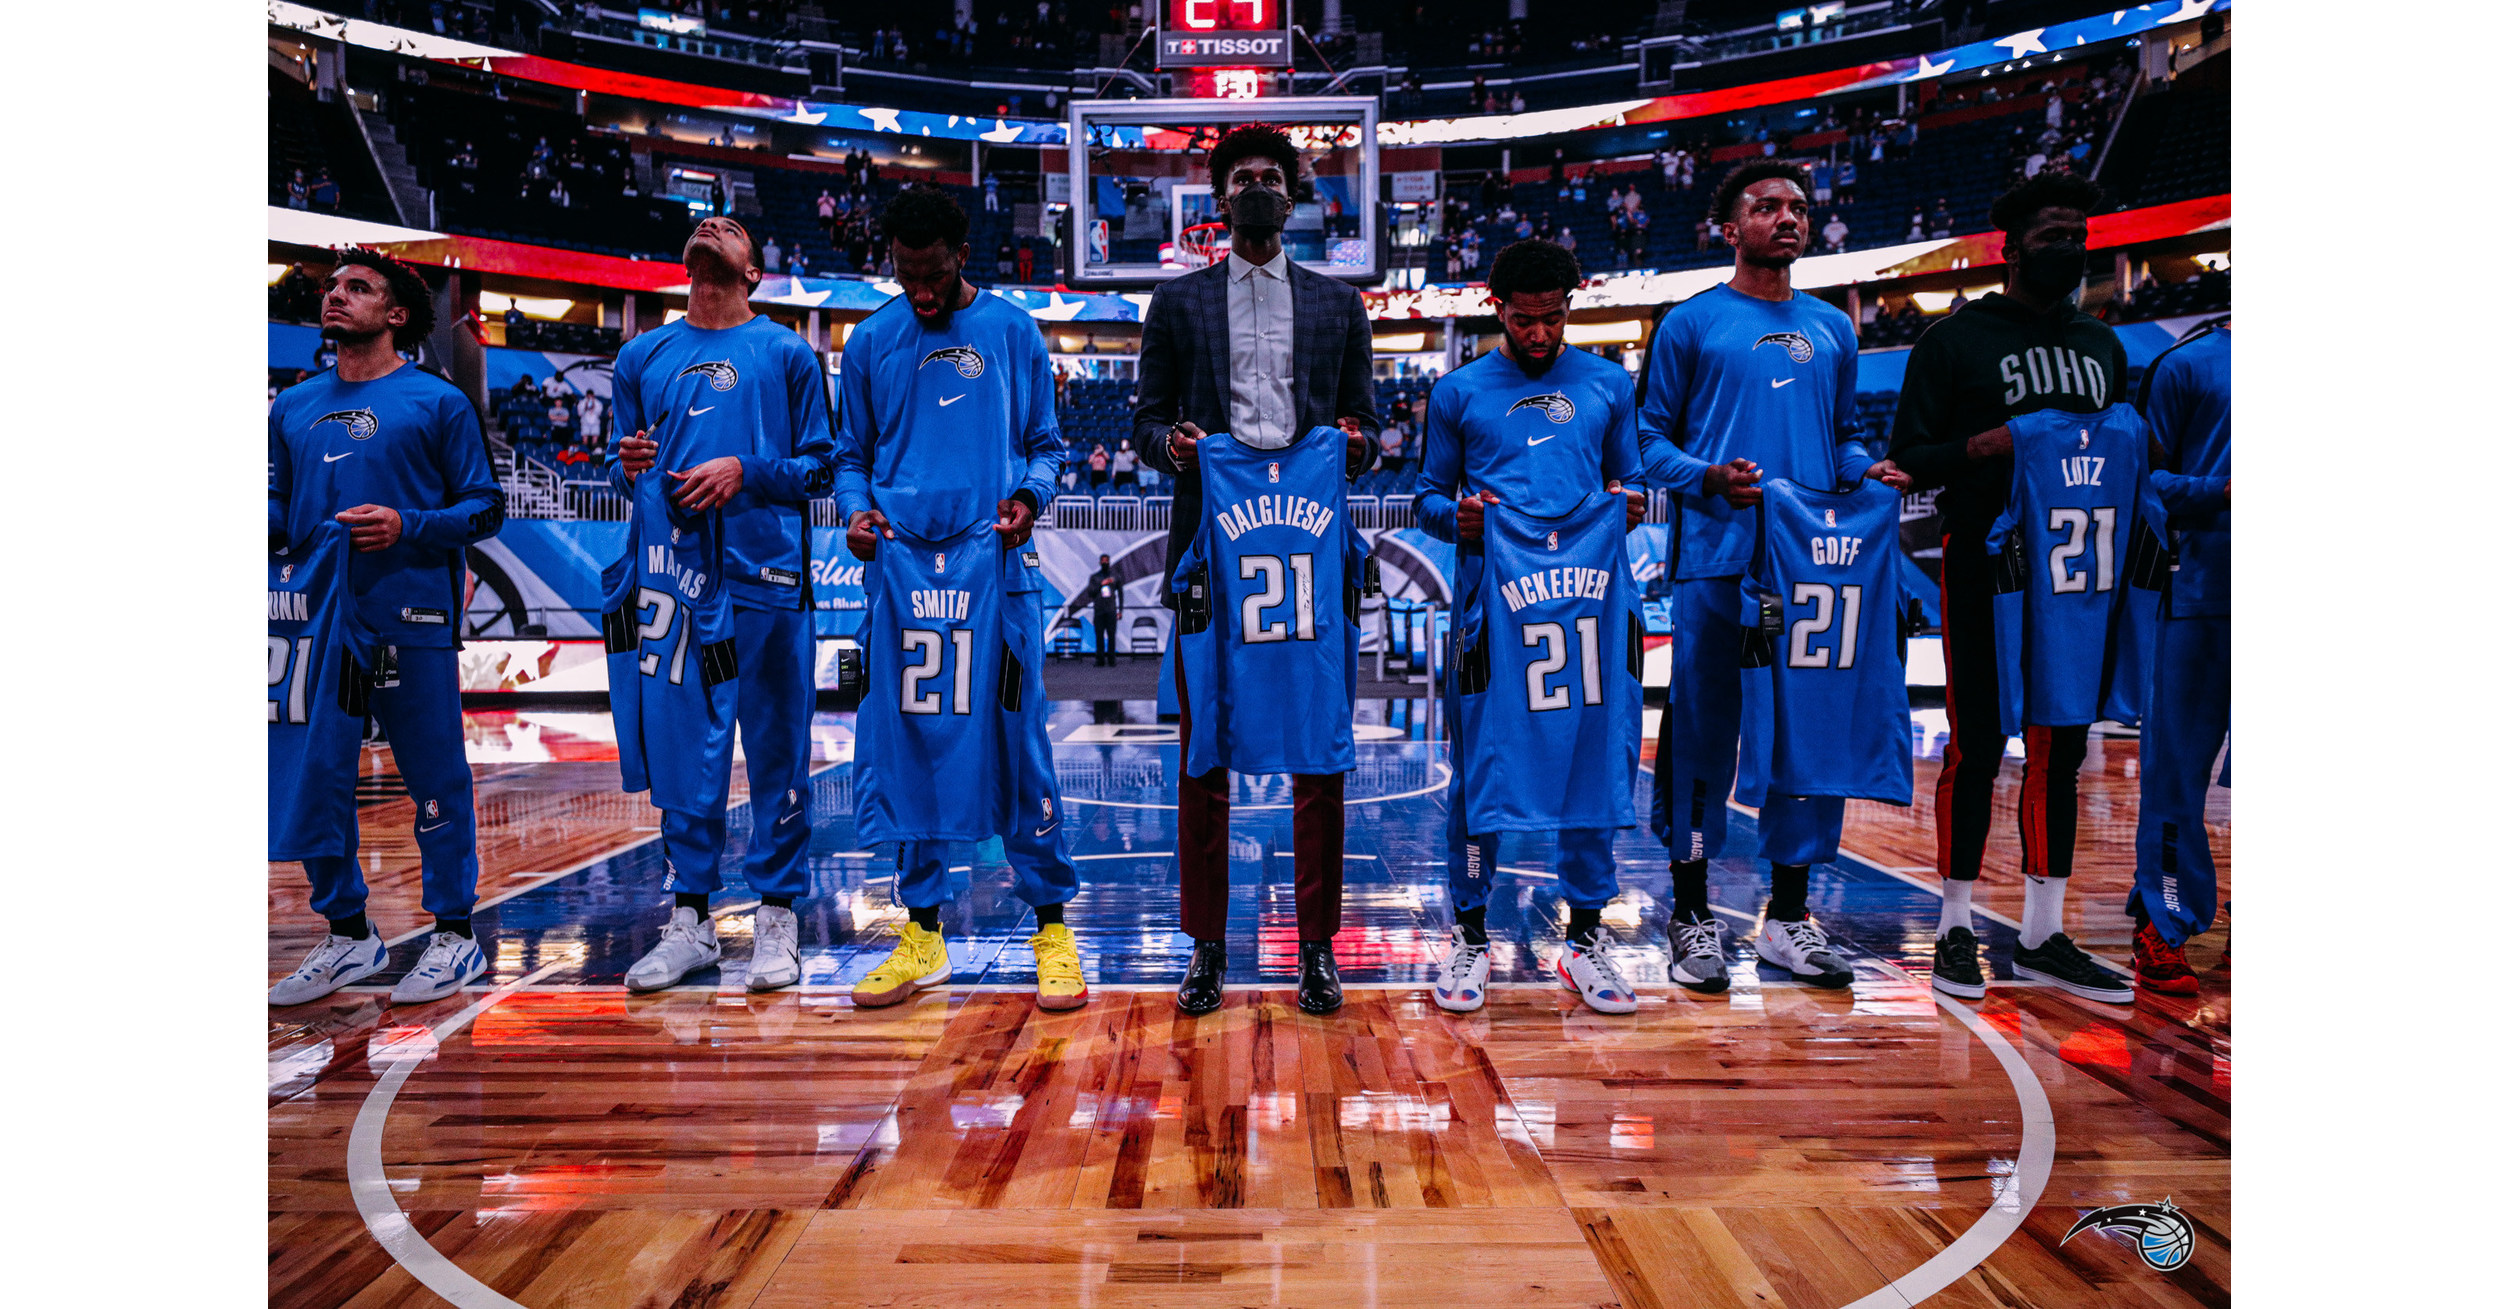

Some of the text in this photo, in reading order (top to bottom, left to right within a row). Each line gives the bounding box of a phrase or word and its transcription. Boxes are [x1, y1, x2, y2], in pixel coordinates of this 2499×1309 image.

[1198, 38, 1283, 54] TISSOT
[2000, 346, 2107, 409] SOHO
[2061, 456, 2105, 487] LUTZ
[1216, 494, 1334, 542] DALGLIESH
[810, 556, 864, 586] Blue
[1811, 536, 1862, 566] GOFF
[2049, 507, 2116, 595] 21
[268, 591, 308, 621] UNN
[911, 590, 970, 620] SMITH
[1239, 553, 1316, 644] 21
[1501, 567, 1610, 613] MCKEEVER
[636, 586, 692, 686] 21
[1788, 582, 1862, 669] 21
[268, 636, 313, 725] 21
[900, 628, 973, 716] 21
[1522, 616, 1604, 713] 21
[1466, 844, 1481, 878] MAGIC
[1690, 831, 1704, 861] MAGI
[2162, 875, 2181, 912] MAGIC
